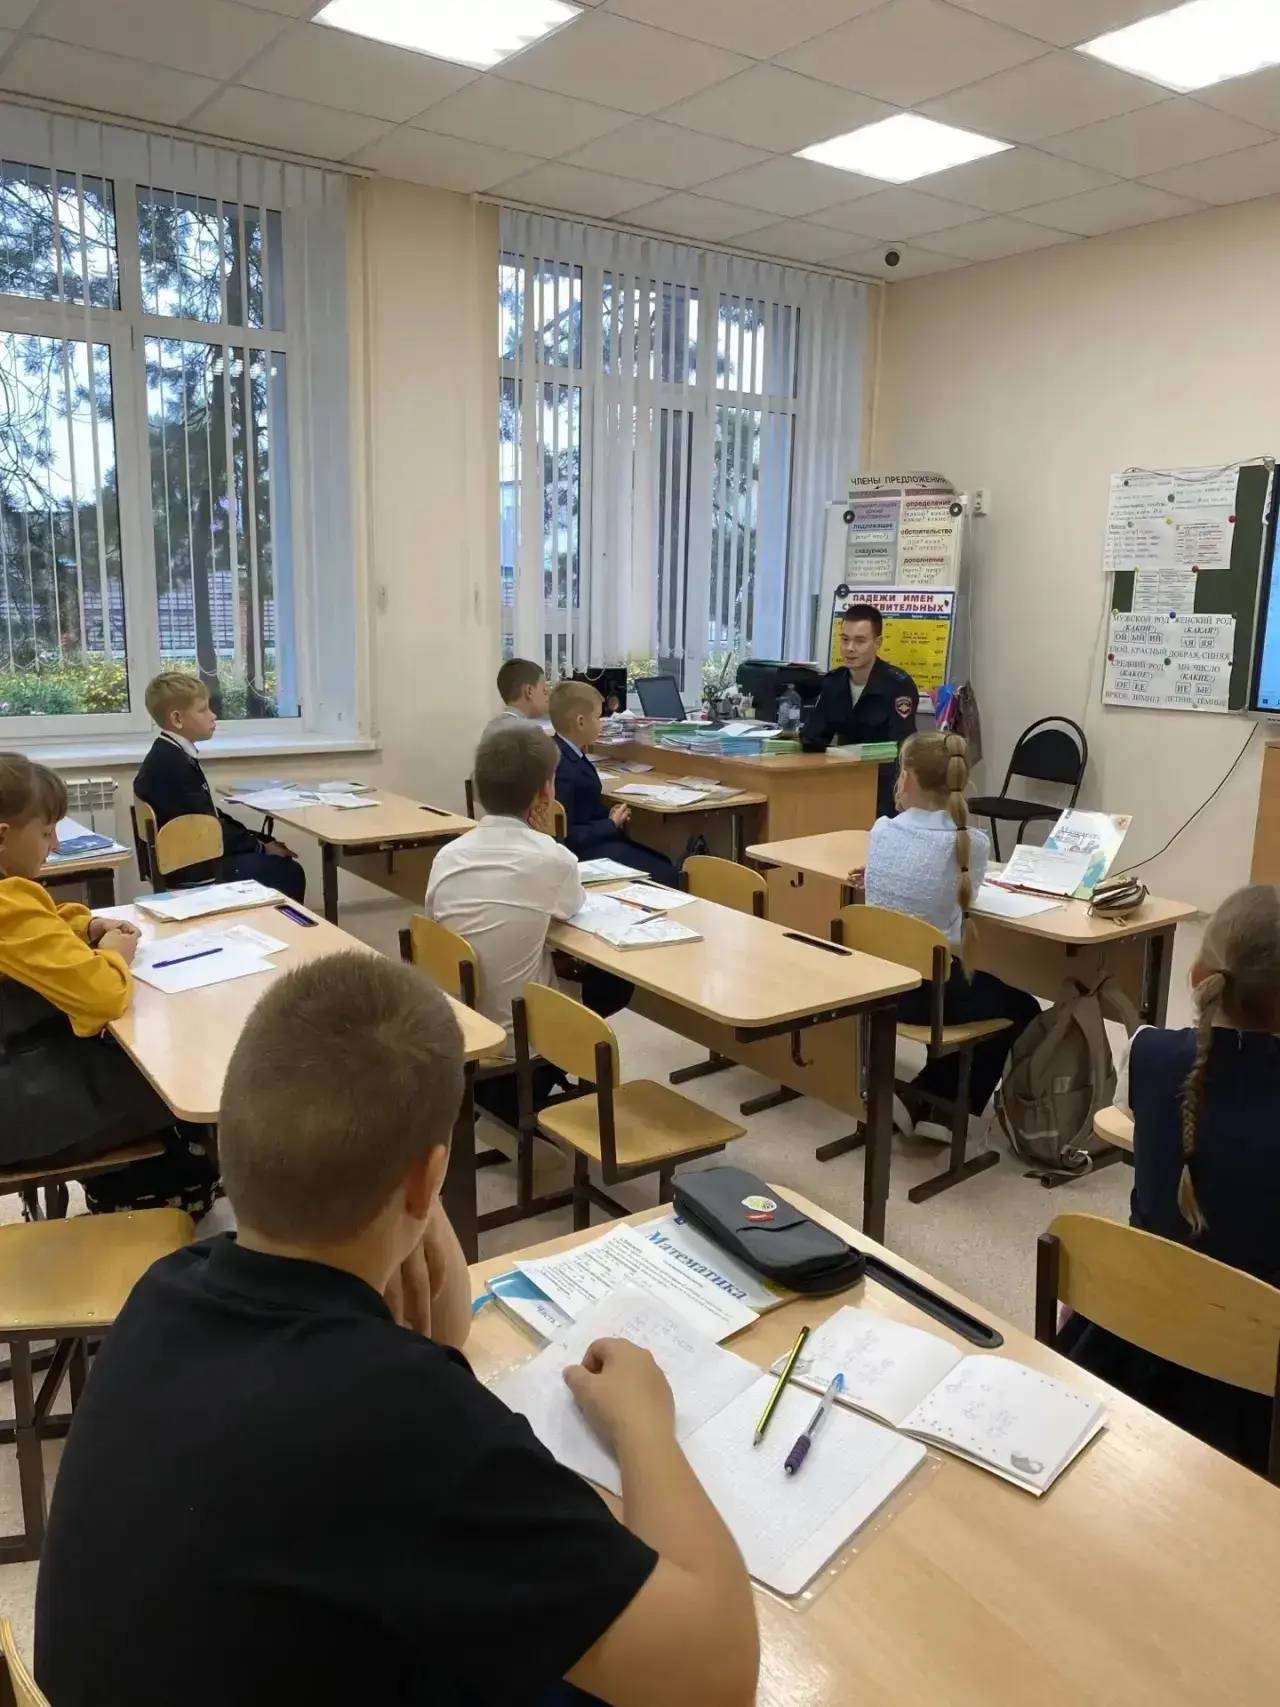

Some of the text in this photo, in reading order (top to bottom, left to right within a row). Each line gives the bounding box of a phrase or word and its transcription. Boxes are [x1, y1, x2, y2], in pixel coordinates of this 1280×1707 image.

[851, 476, 881, 486] ЧЛЕНЫ
[905, 500, 951, 508] определение
[853, 594, 934, 603] ПАДЕЖИ ИМЕН
[1174, 616, 1213, 625] ЖЕНСКИЙ
[1115, 633, 1127, 641] ОЙ
[1201, 652, 1230, 660] СИНЯЯ
[1148, 663, 1164, 671] РОД
[1193, 664, 1221, 673] ЧИСЛО
[645, 1230, 748, 1300] Математика
